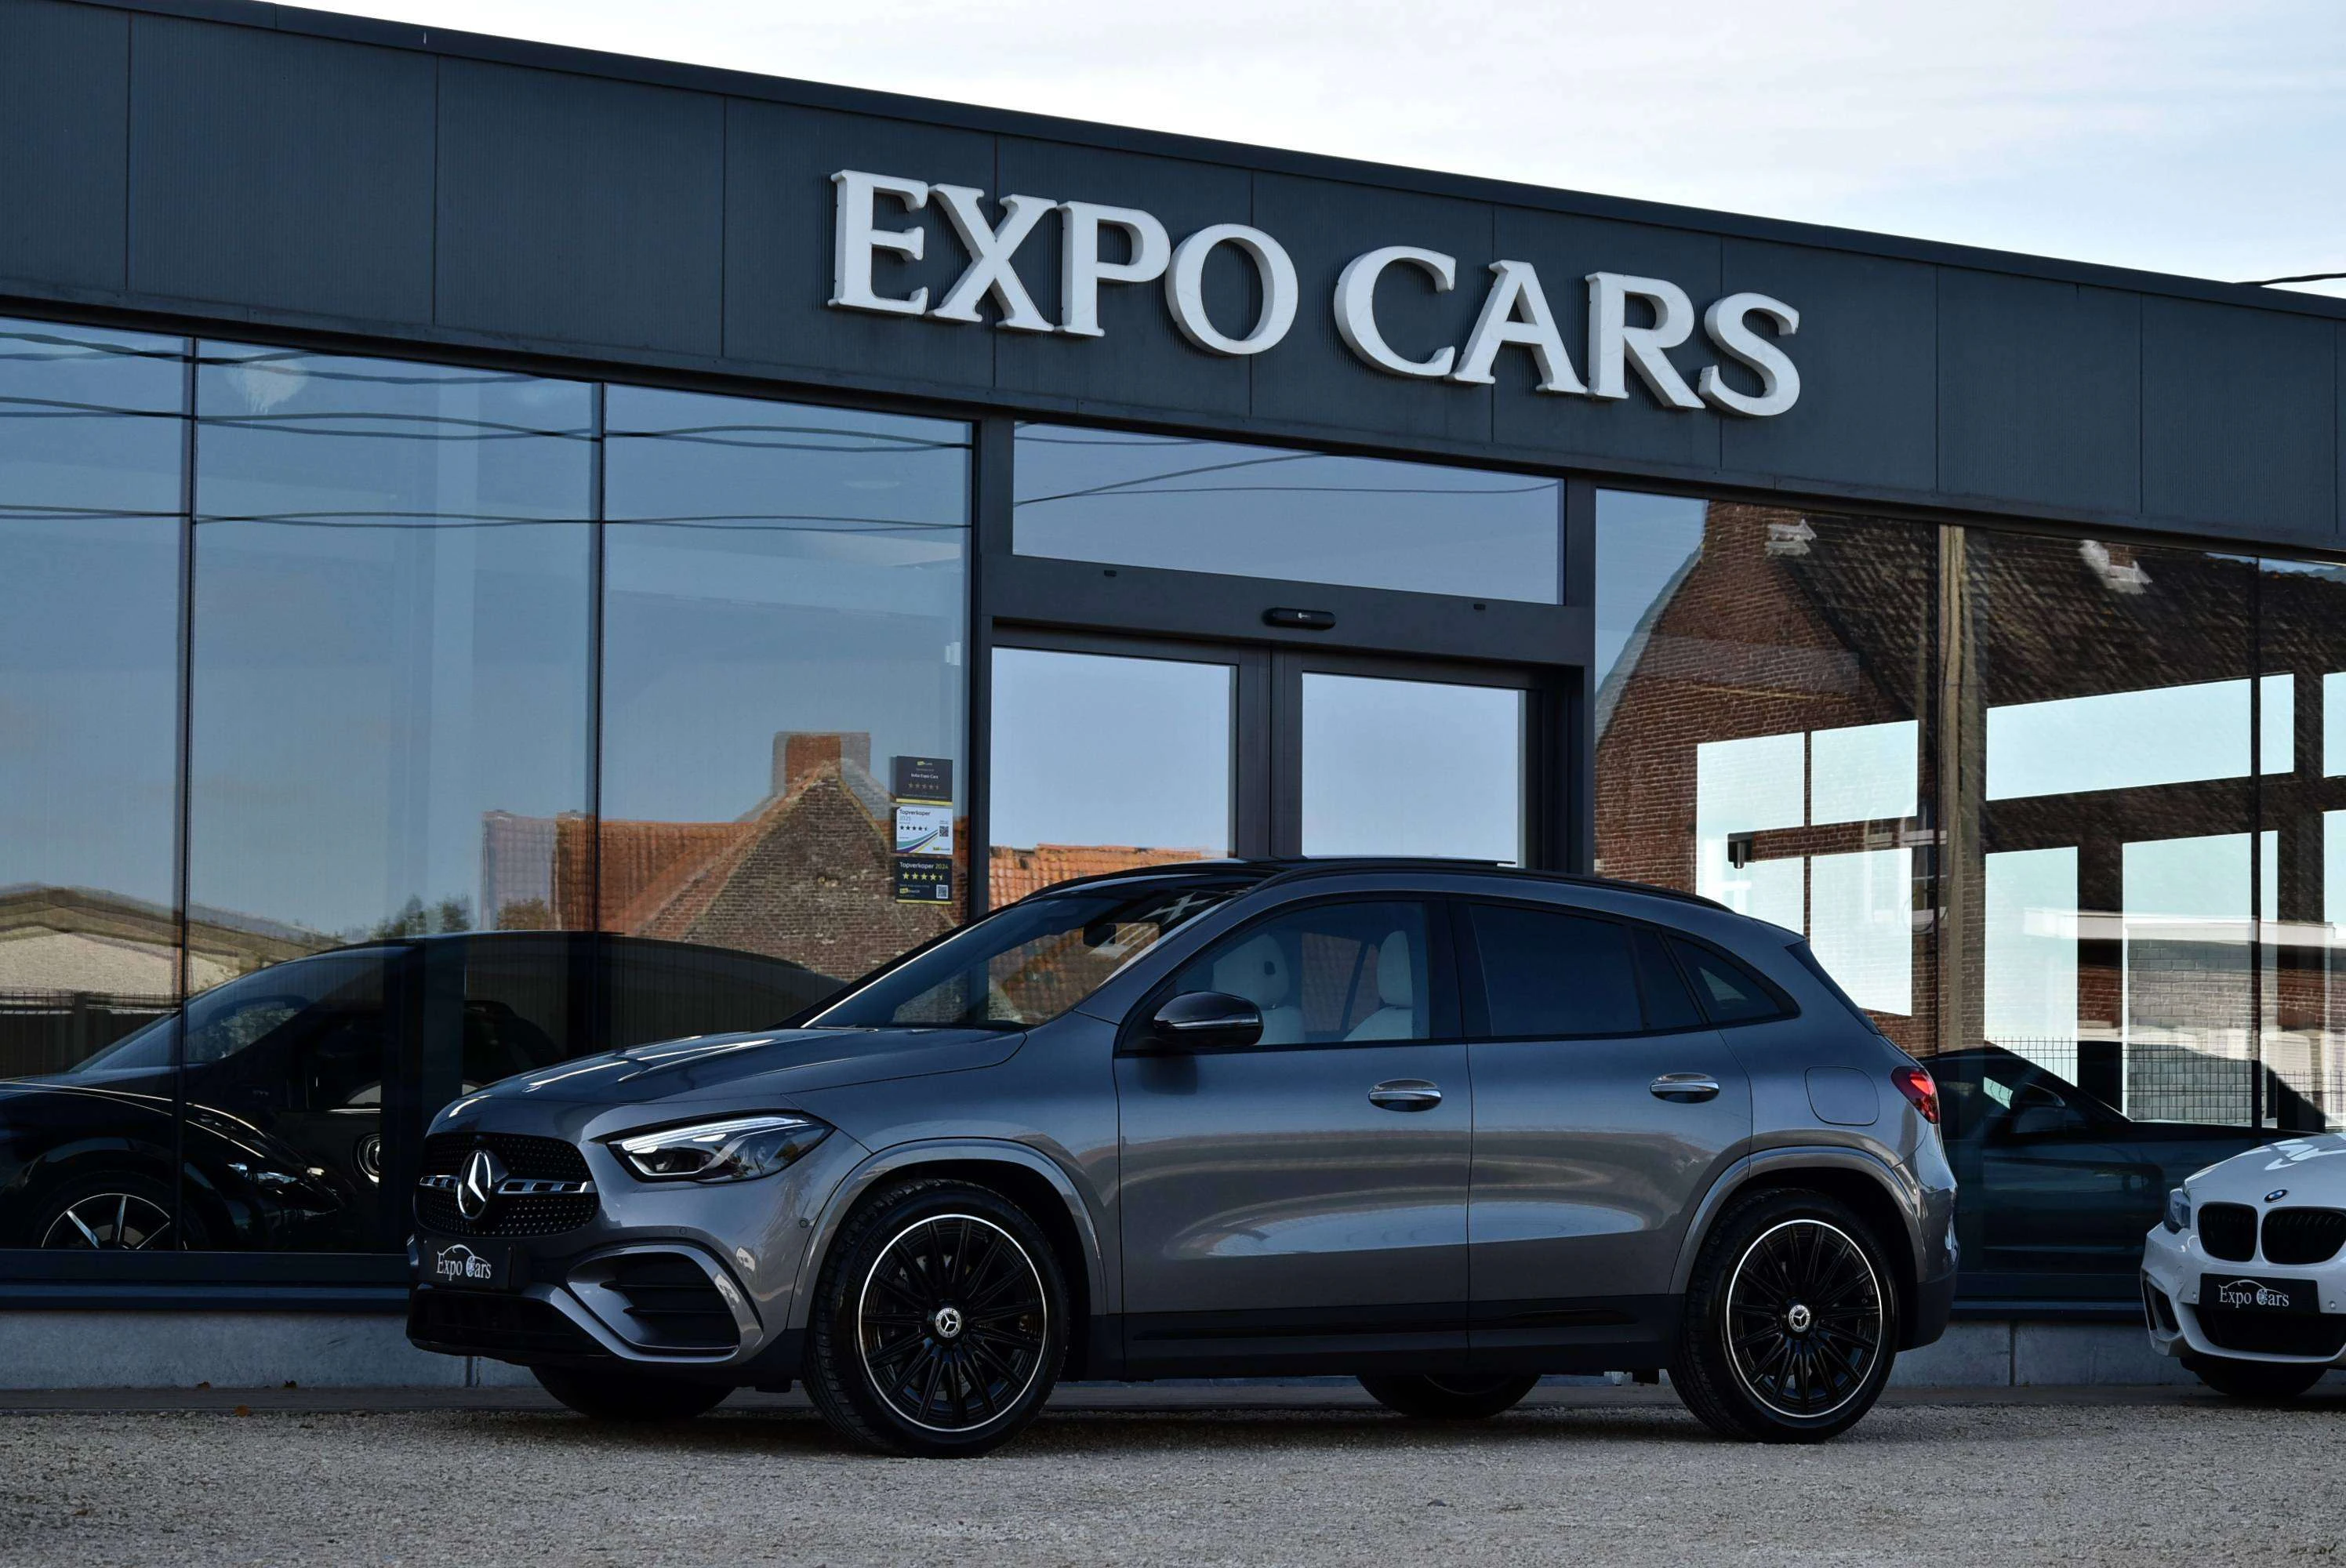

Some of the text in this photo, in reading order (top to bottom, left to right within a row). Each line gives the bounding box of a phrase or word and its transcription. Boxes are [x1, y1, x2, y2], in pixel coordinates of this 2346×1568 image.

[827, 169, 1801, 416] EXPO CARS
[436, 1251, 492, 1281] Expo Cars
[2219, 1286, 2290, 1308] Expo Cars
